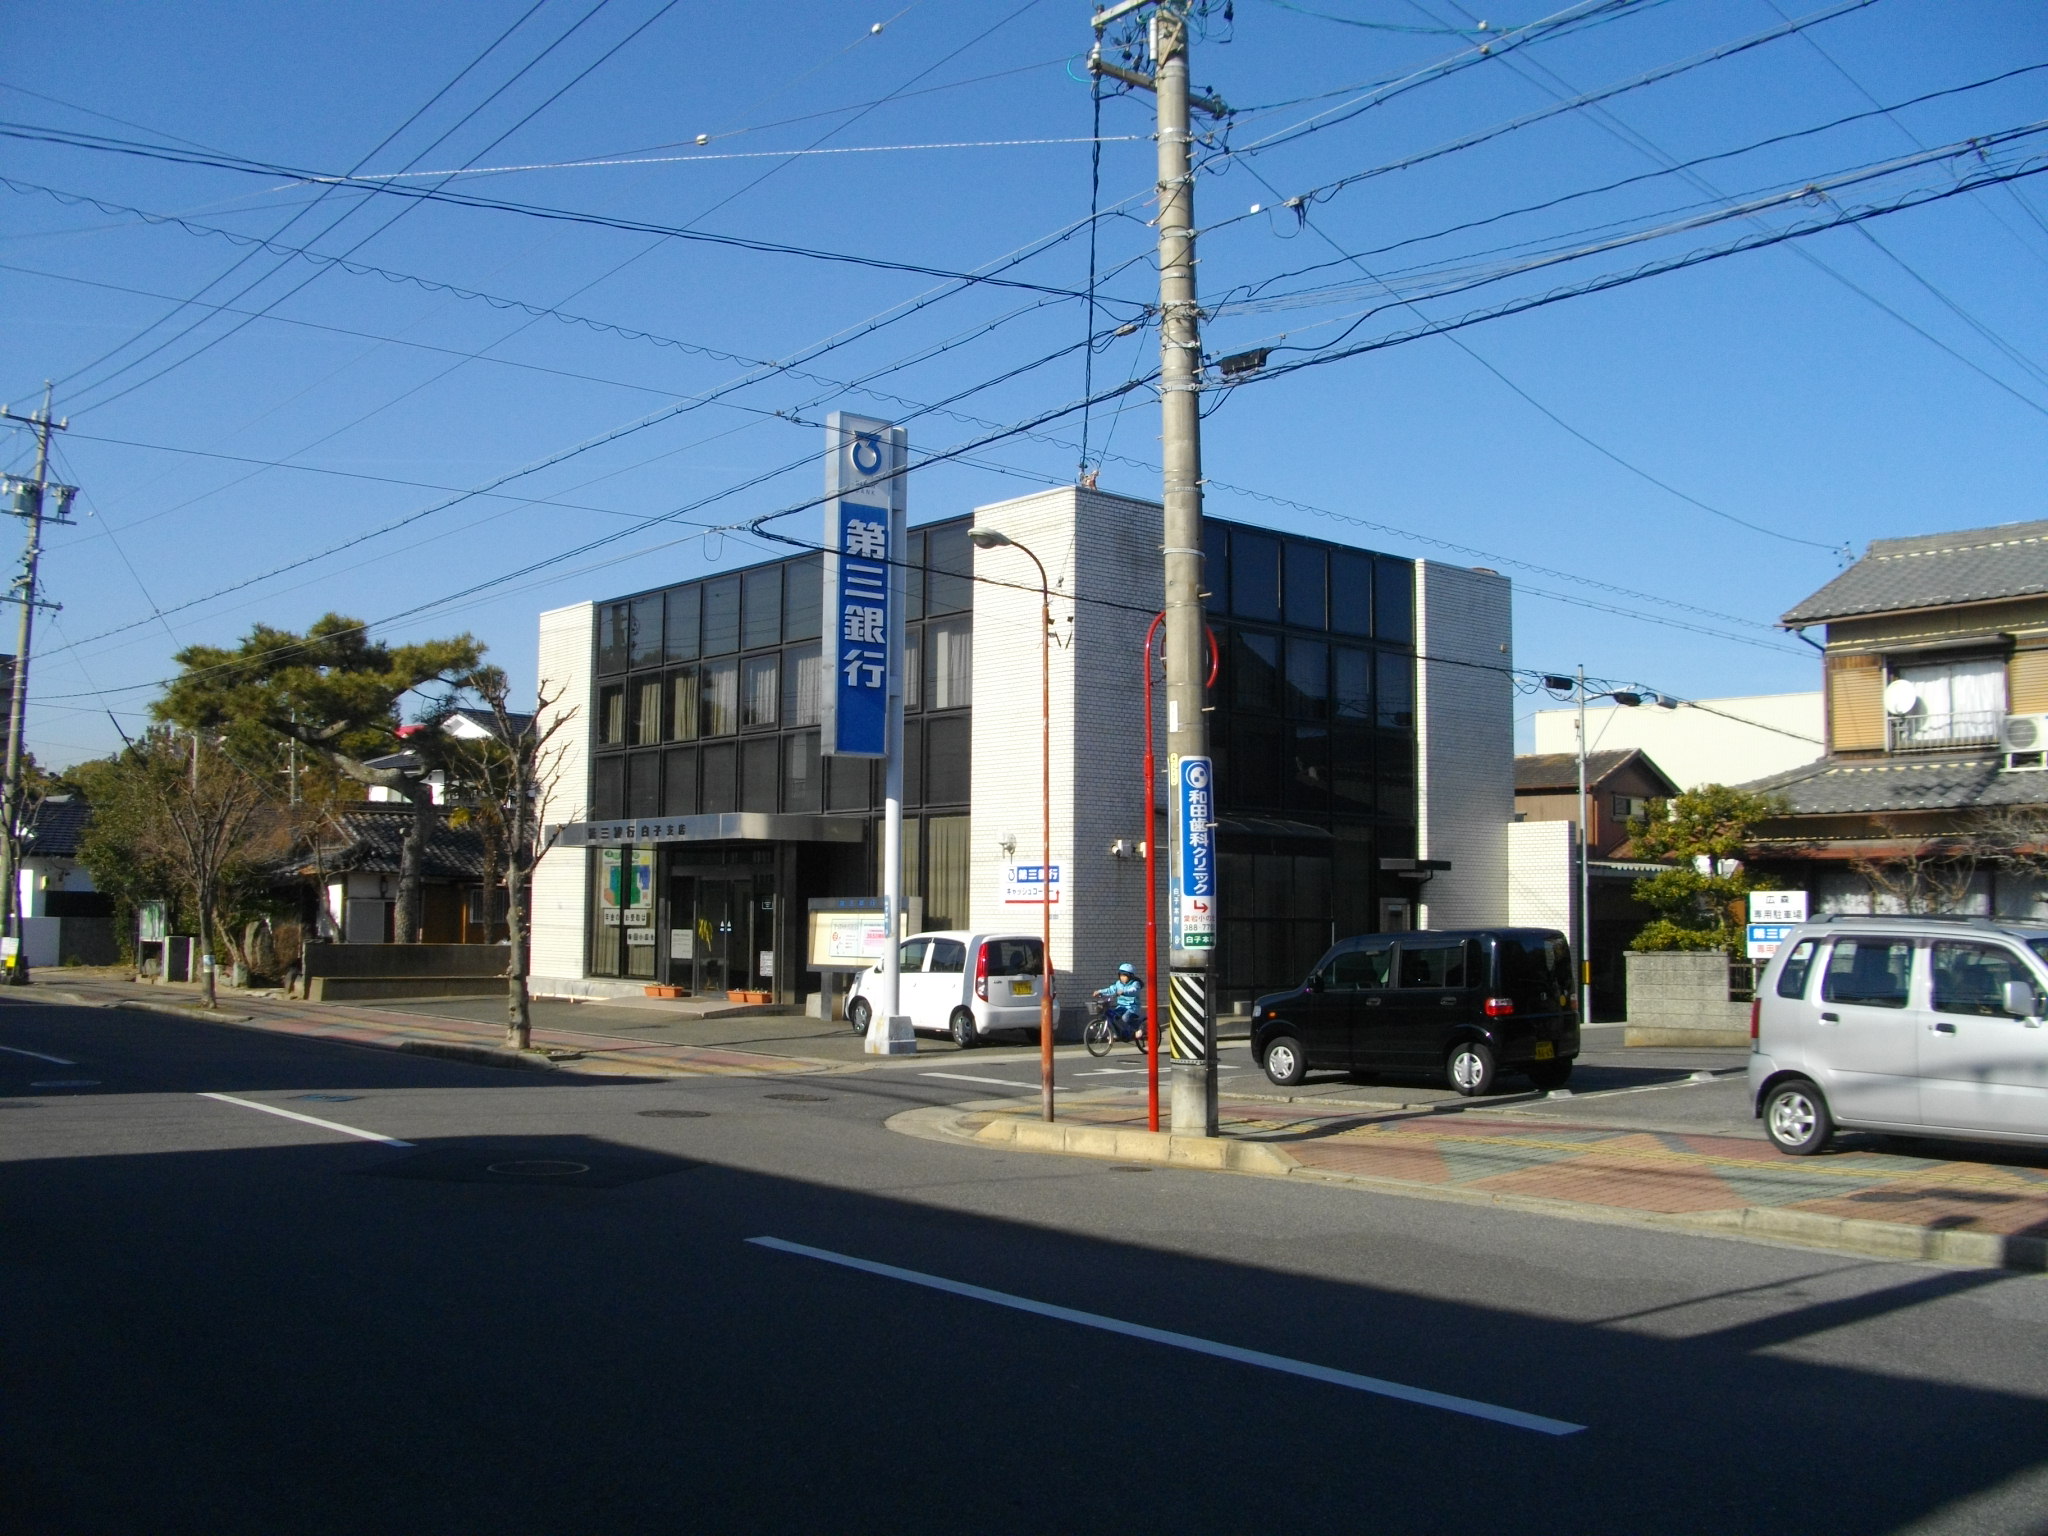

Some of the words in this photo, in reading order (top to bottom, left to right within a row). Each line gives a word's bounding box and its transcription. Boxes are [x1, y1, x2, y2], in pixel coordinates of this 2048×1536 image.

[842, 519, 886, 688] 第三銀行
[1188, 790, 1209, 894] 和田歯科クリニック
[1753, 928, 1791, 939] 第三銀
[1754, 910, 1802, 919] 専用駐車場
